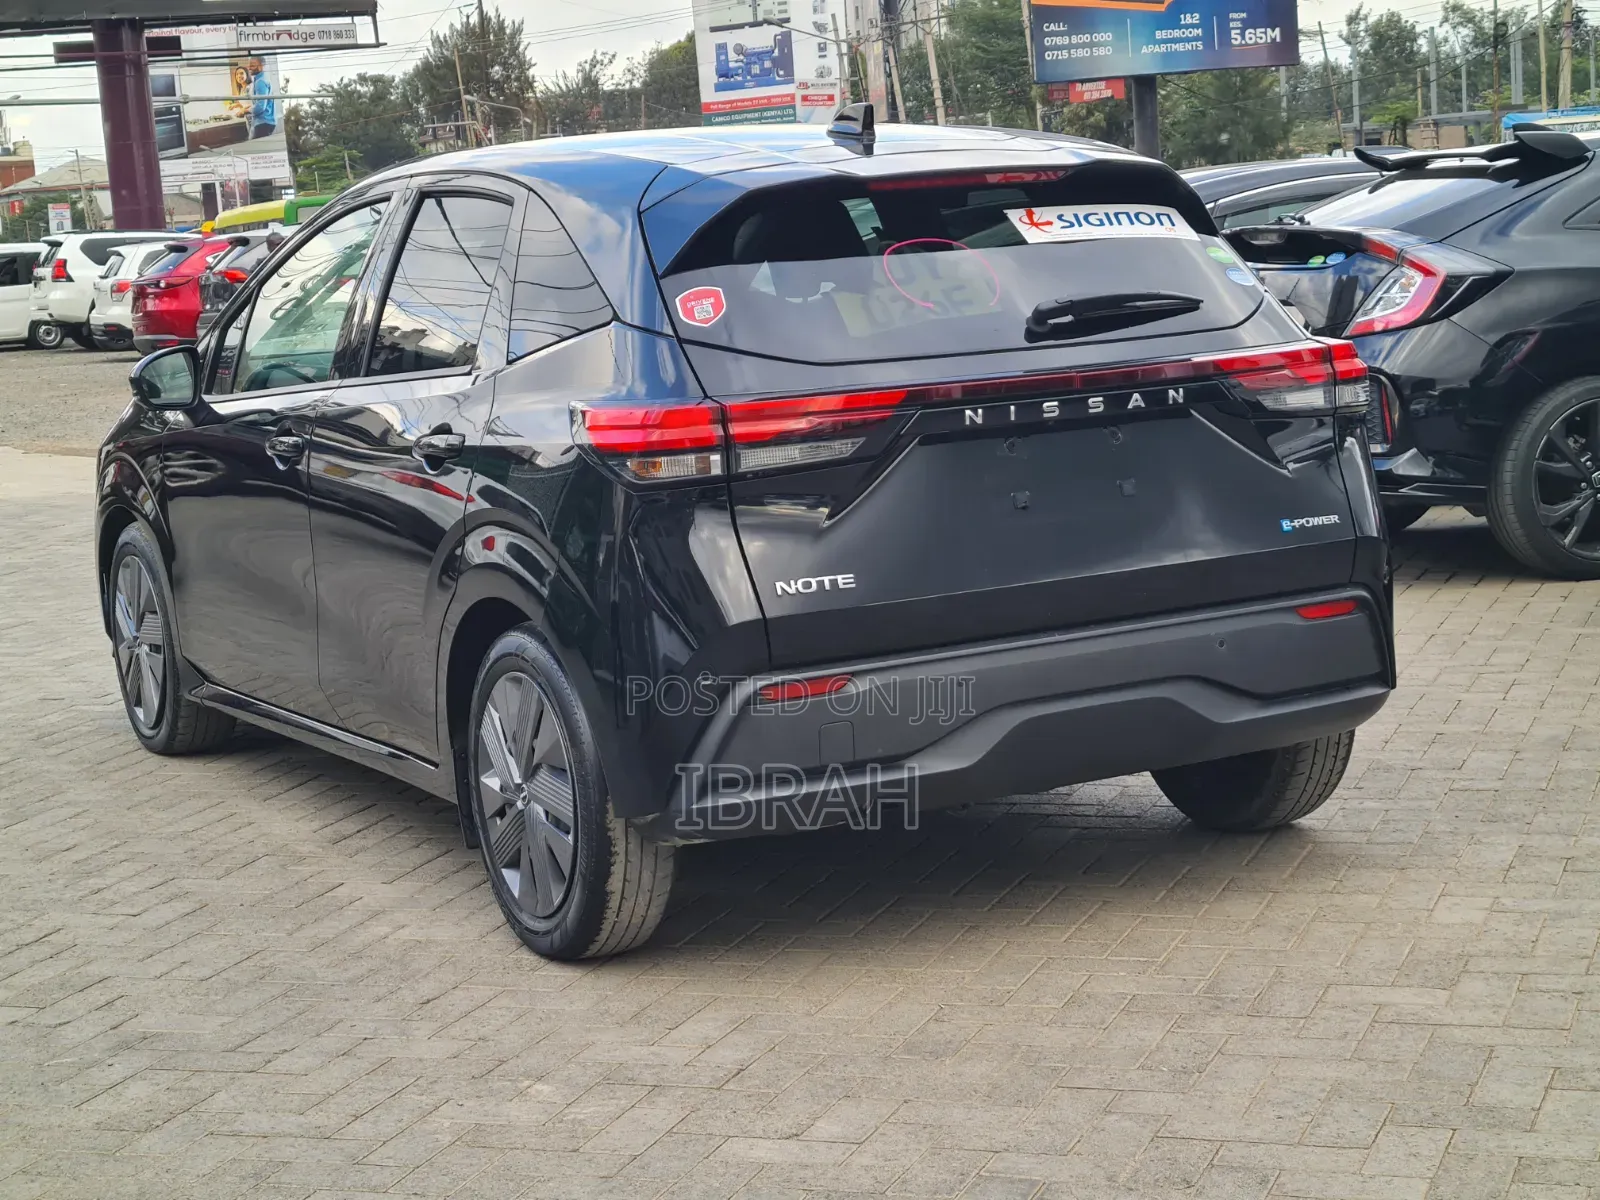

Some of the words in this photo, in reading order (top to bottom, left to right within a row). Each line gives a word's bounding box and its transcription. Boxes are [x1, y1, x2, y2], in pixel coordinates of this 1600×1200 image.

[1180, 13, 1200, 24] 1&2
[174, 27, 203, 35] flavour,
[1043, 22, 1067, 32] CALL:
[1155, 28, 1202, 39] BEDROOM
[345, 29, 355, 39] 333
[1044, 35, 1070, 46] 0769
[1070, 33, 1091, 44] 800
[1092, 32, 1113, 42] 000
[1230, 27, 1281, 45] 5.65M
[1044, 49, 1070, 60] 0715
[1070, 47, 1091, 58] 580
[1092, 46, 1113, 56] 580
[1141, 41, 1203, 54] APARTMENTS
[731, 111, 762, 120] EQUIPMENT
[964, 387, 1185, 426] NISSAN
[1280, 514, 1341, 533] e-POWER
[774, 573, 856, 596] NOTE
